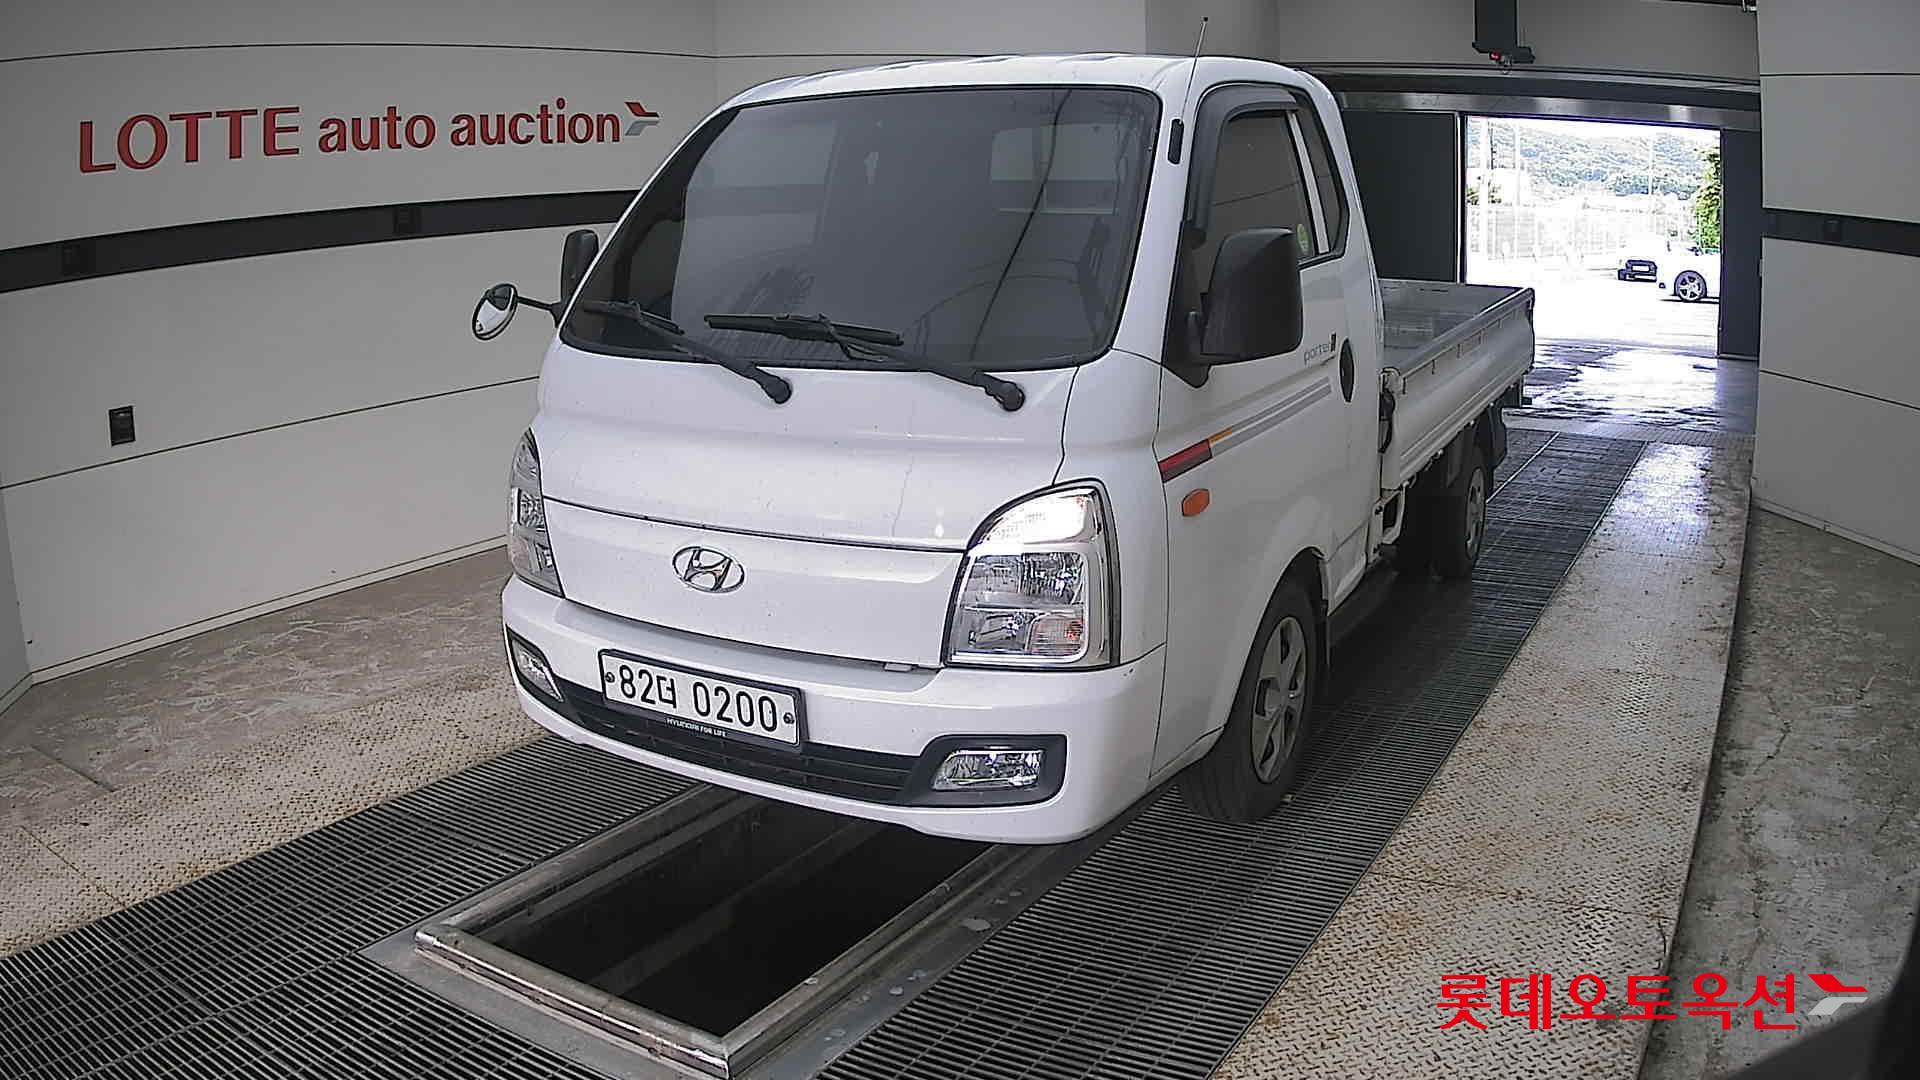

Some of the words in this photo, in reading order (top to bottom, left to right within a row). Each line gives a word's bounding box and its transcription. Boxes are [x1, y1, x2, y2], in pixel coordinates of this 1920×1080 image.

[79, 106, 300, 173] LOTTE
[318, 106, 436, 153] auto
[450, 98, 621, 147] auction
[618, 664, 677, 709] 82더
[692, 681, 778, 732] 0200
[700, 725, 713, 735] FOR
[713, 728, 729, 738] LIFE
